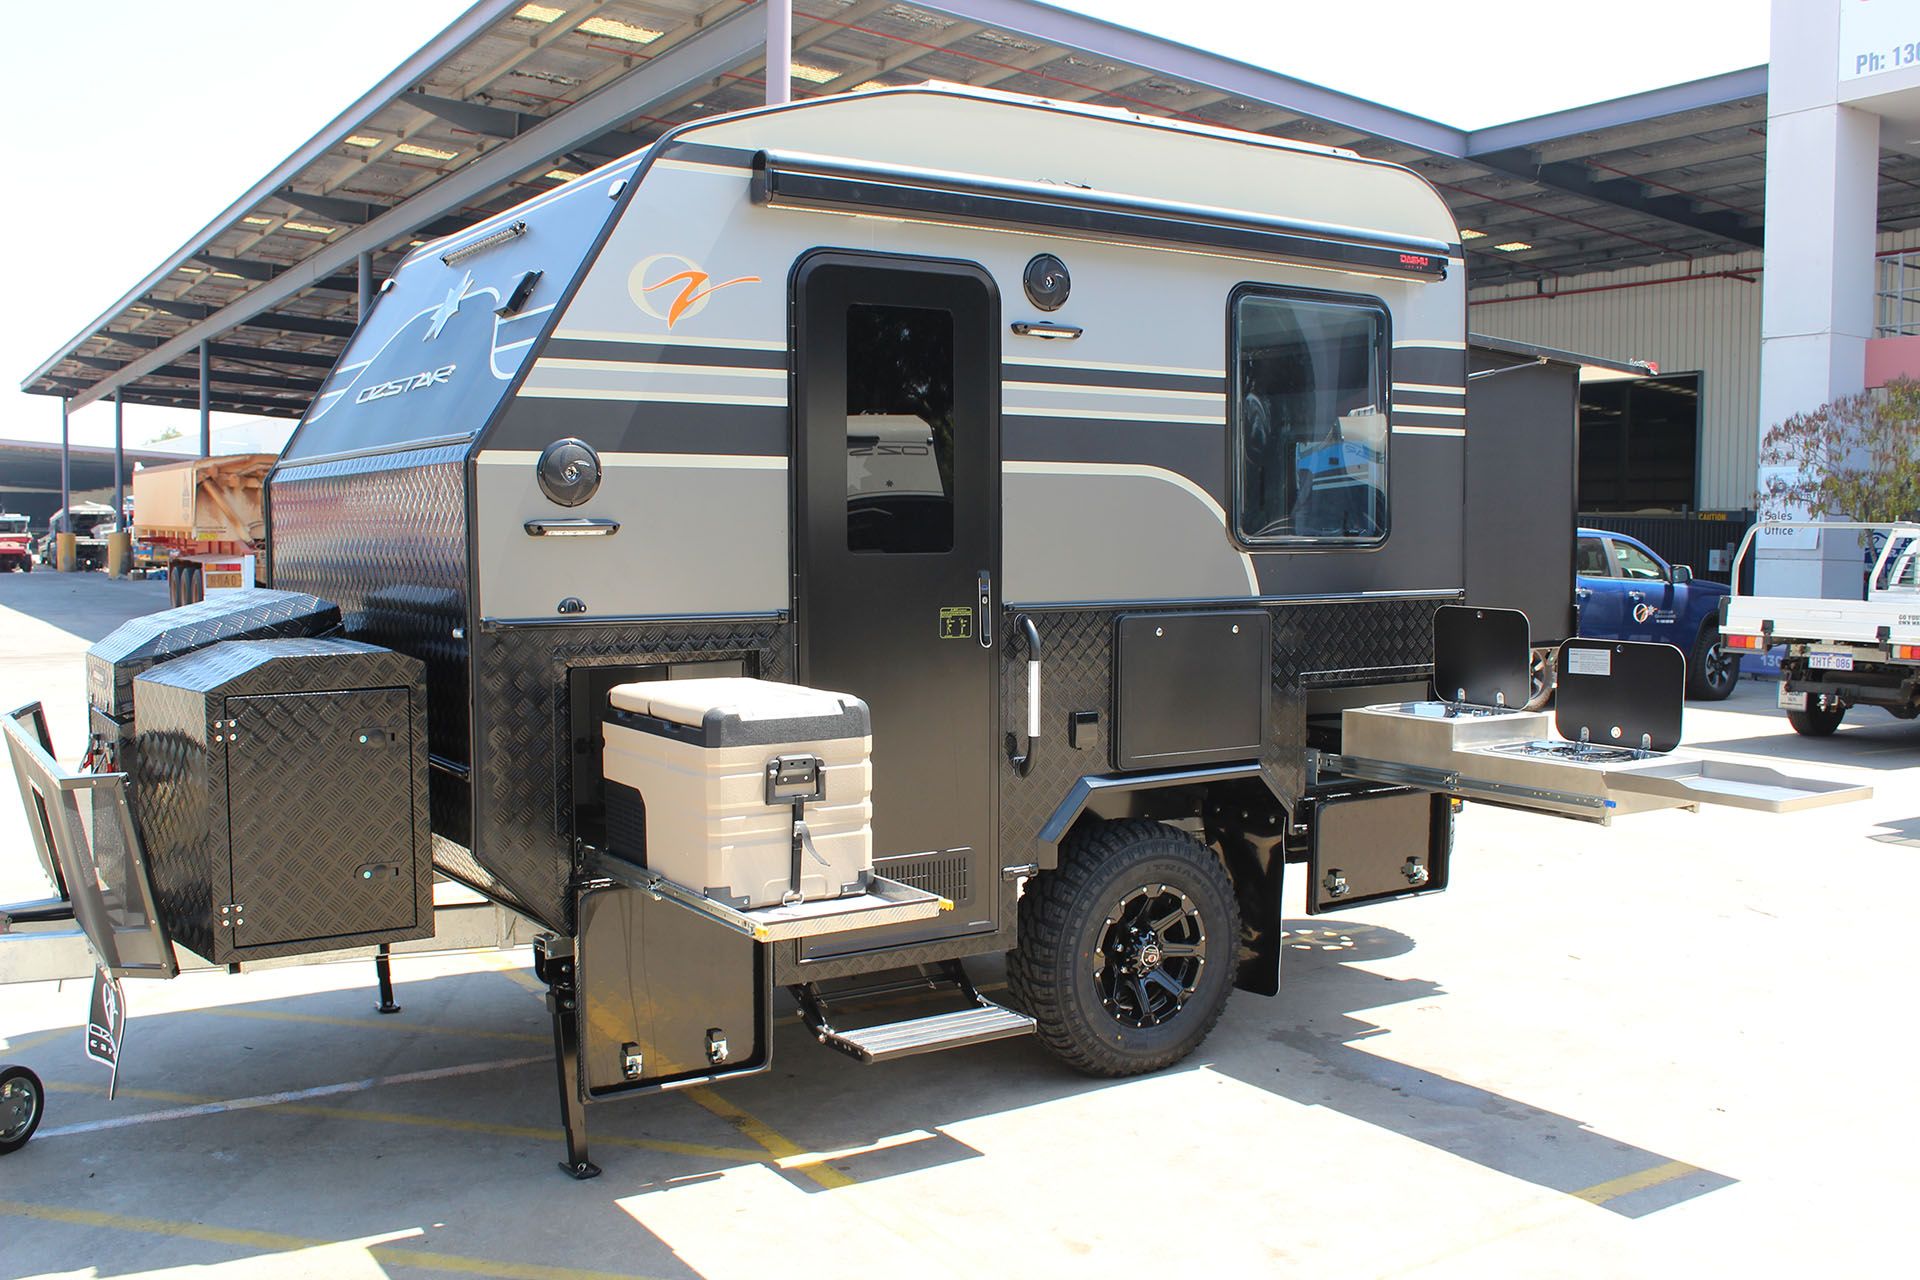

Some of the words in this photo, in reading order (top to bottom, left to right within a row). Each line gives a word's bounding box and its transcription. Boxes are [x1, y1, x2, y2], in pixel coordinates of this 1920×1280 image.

[1855, 52, 1885, 75] Ph:
[355, 364, 457, 405] OZSTAR
[1764, 510, 1793, 521] Sales
